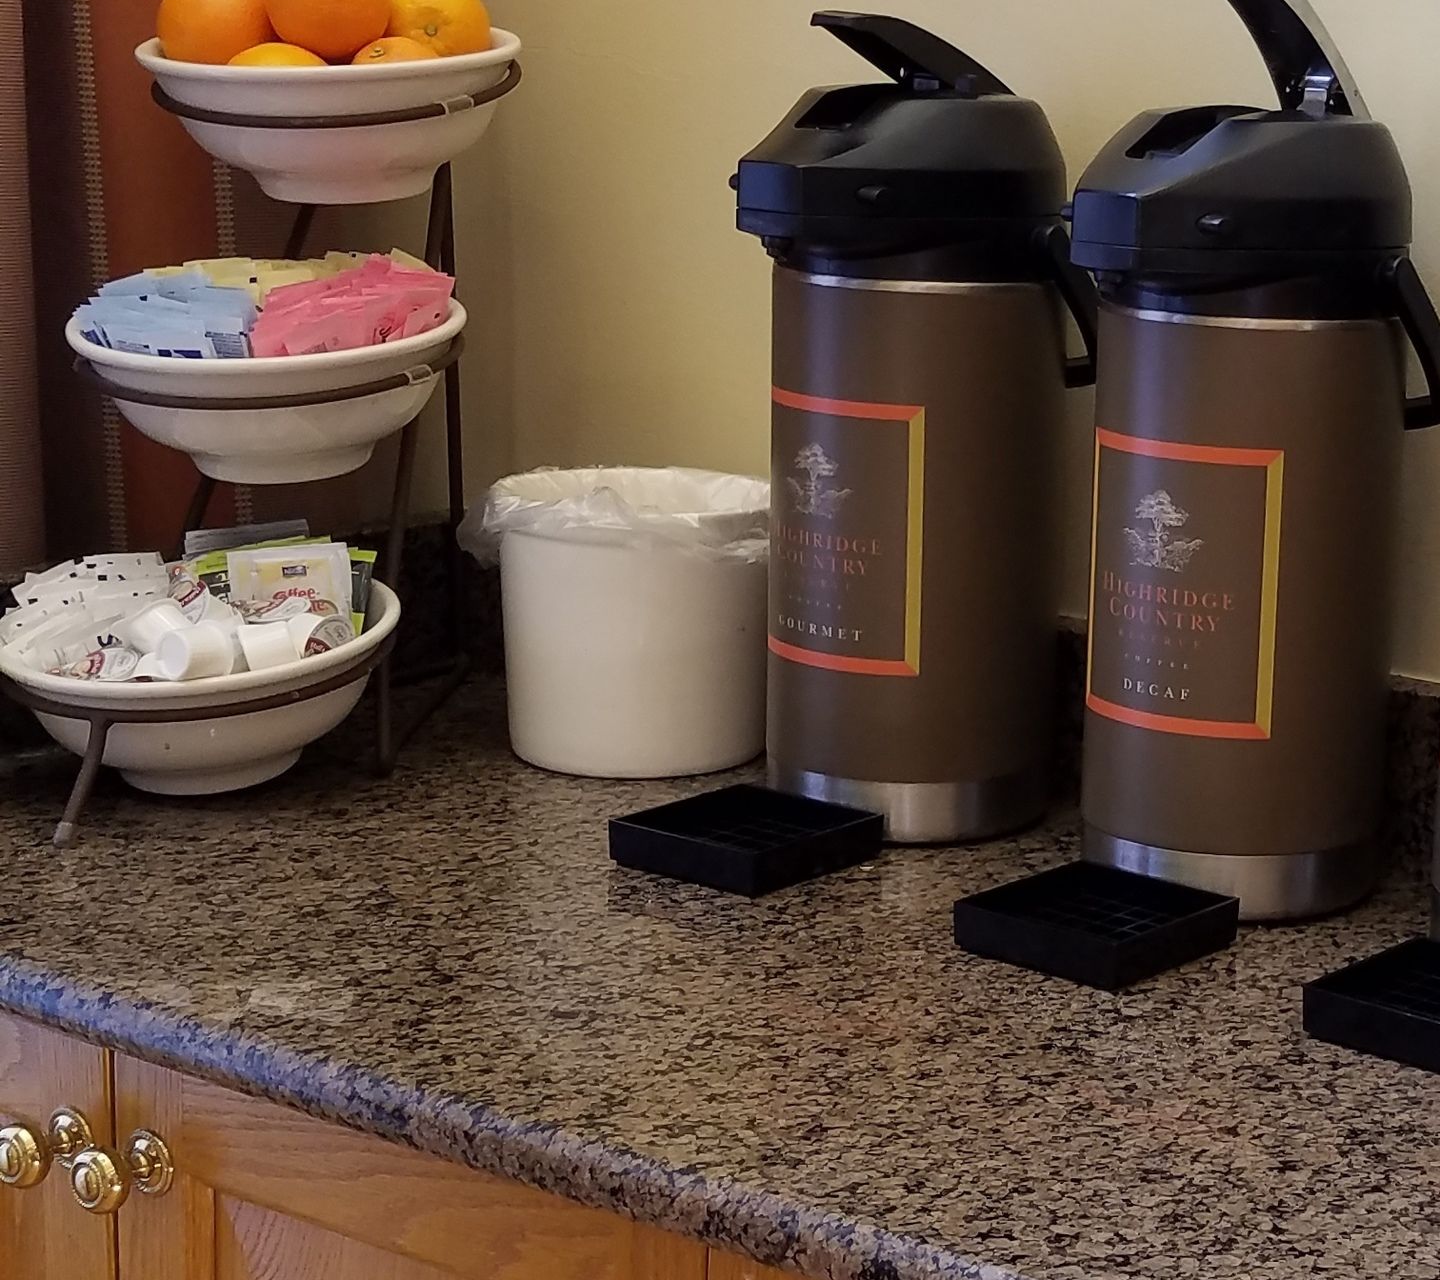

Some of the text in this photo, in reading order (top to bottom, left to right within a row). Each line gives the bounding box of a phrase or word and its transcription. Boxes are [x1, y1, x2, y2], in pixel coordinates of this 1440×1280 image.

[1103, 570, 1234, 611] HIGHRIDGE
[778, 614, 863, 642] GOURMET
[1110, 596, 1220, 631] COUNTRY
[1123, 677, 1190, 700] DECAF
